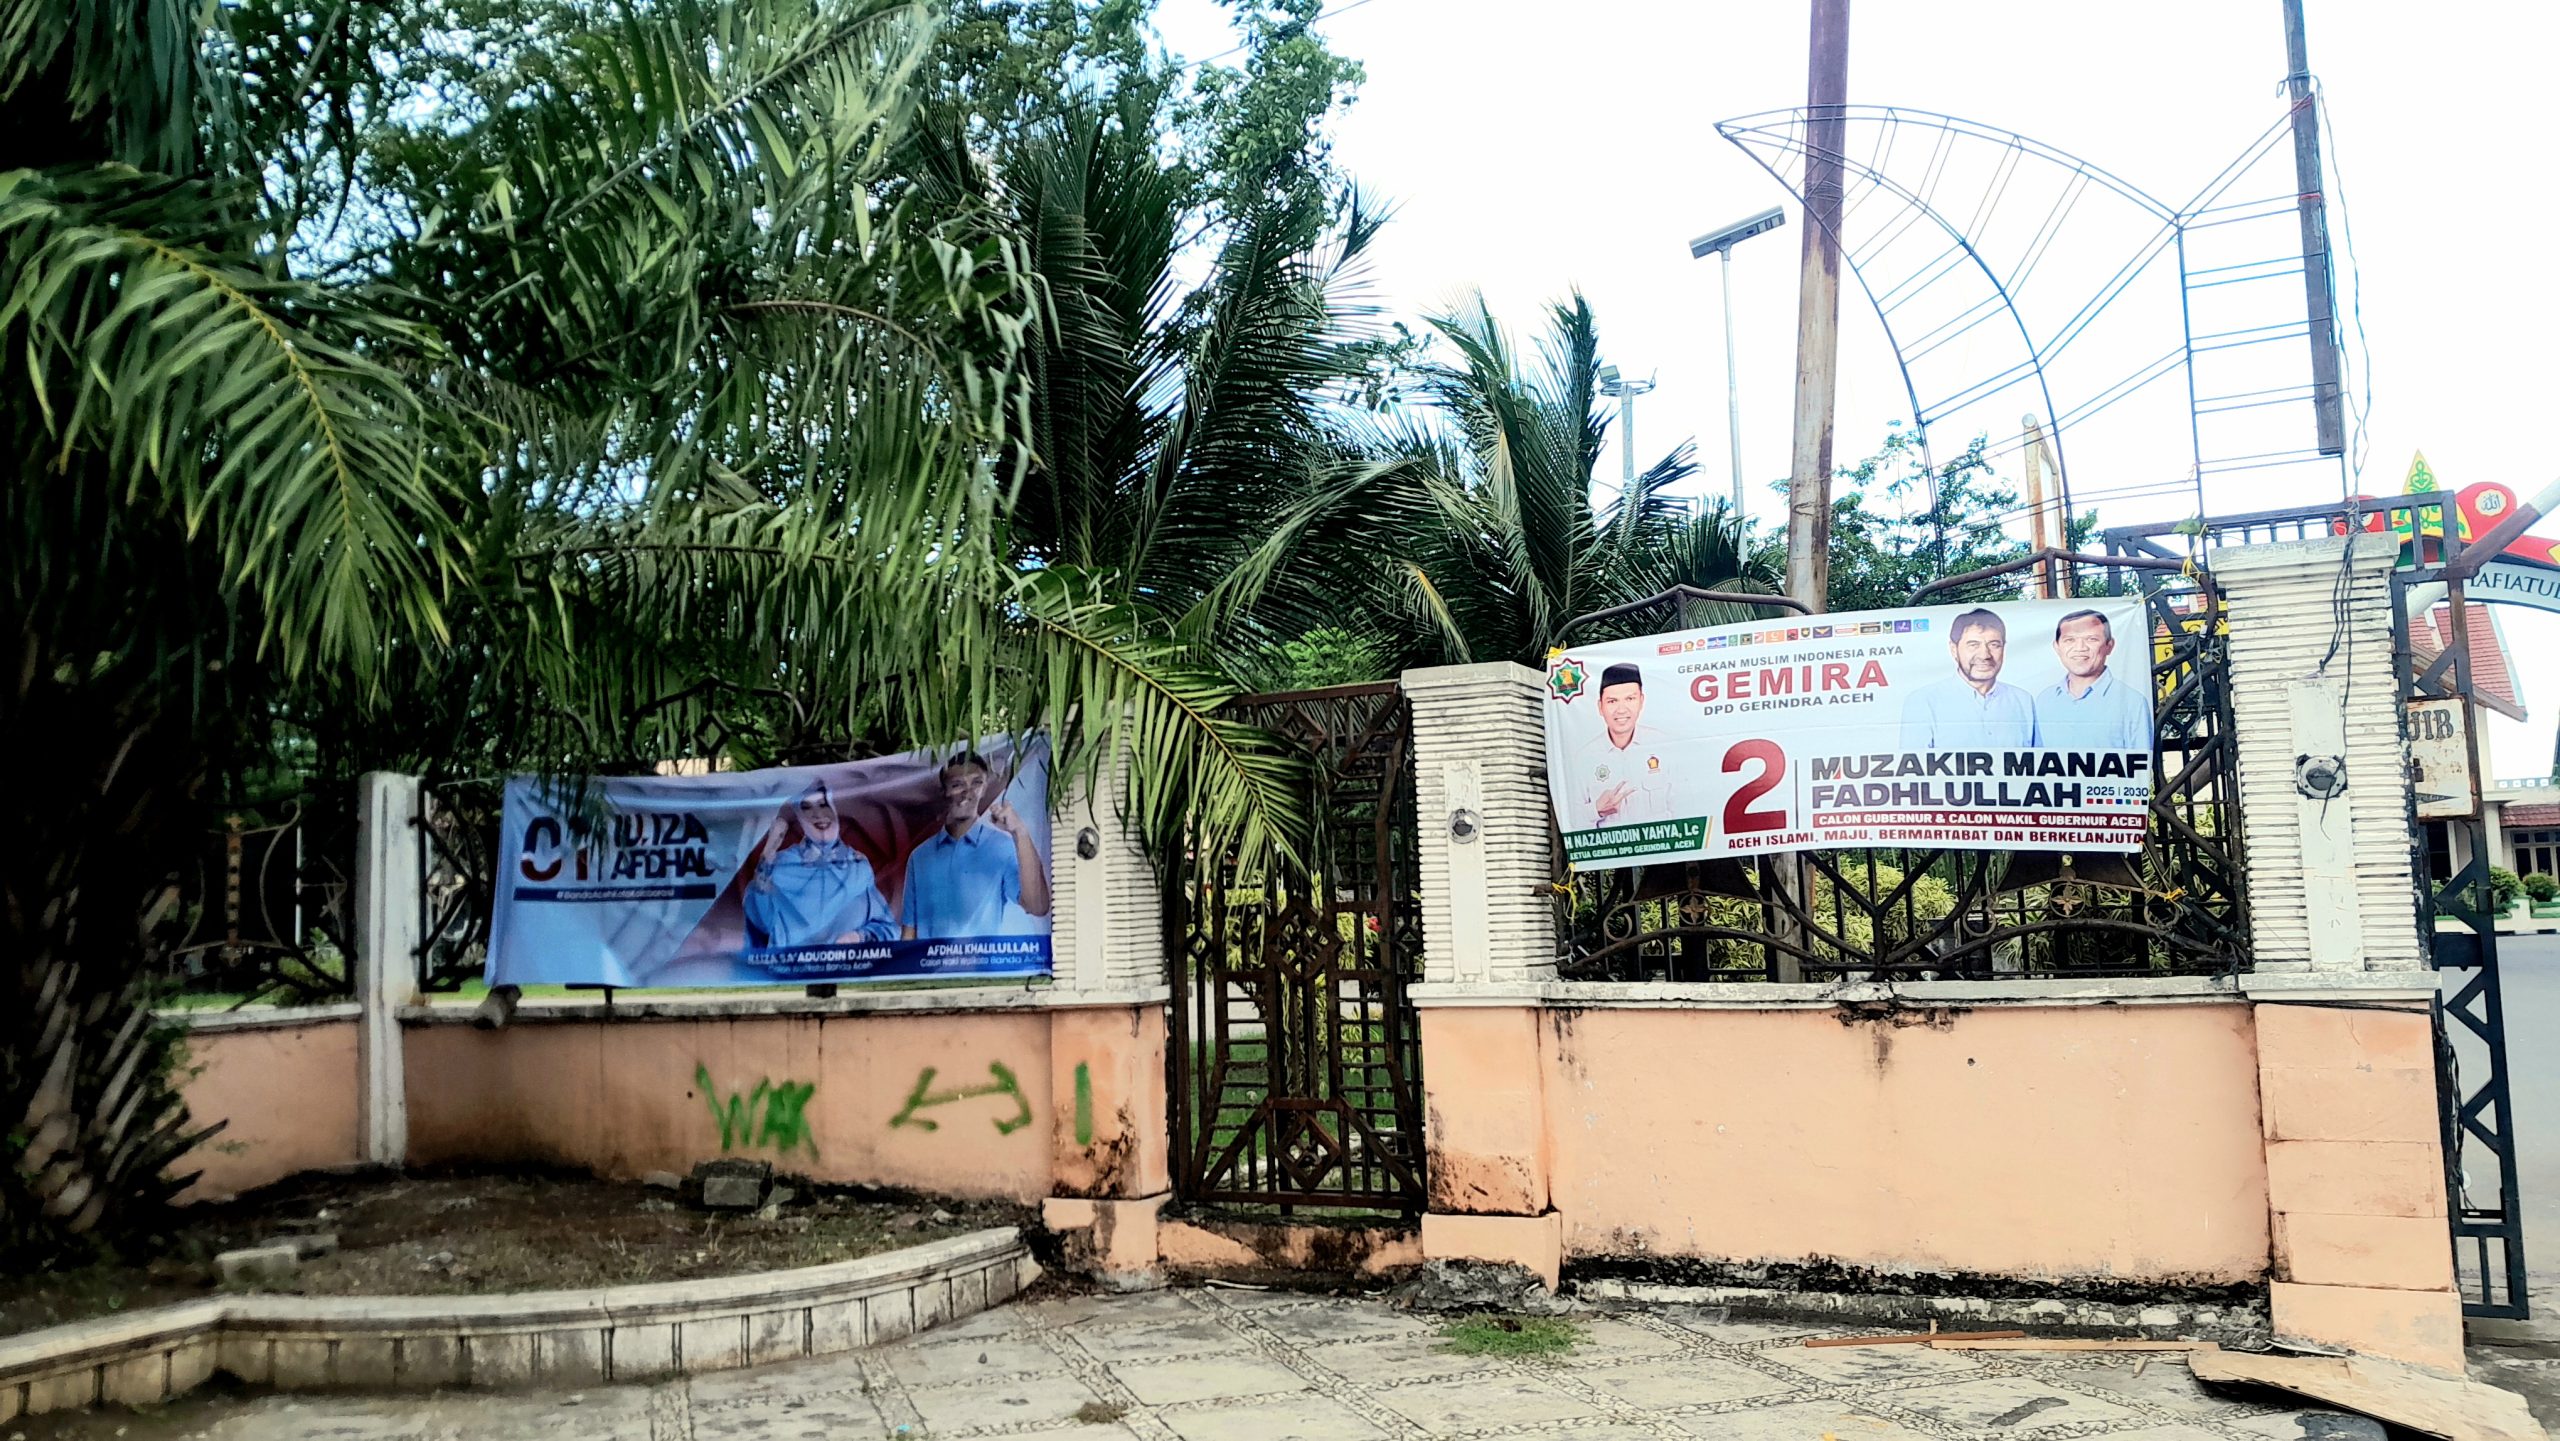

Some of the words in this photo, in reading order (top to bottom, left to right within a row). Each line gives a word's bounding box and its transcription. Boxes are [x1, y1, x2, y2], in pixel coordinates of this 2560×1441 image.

[1678, 657, 1736, 674] GERAKAN
[1740, 654, 1789, 668] MUSLIM
[1793, 648, 1867, 663] INDONESIA
[1869, 646, 1904, 657] RAYA
[1690, 660, 1889, 703] GEMIRA
[1704, 703, 1734, 716] DPD
[1740, 697, 1823, 712] GERINDRA
[1829, 692, 1874, 704] ACEH
[1811, 752, 1994, 781] MUZAKIR
[2003, 752, 2148, 778] MANAF
[1721, 738, 1787, 835] 2
[1811, 782, 2081, 809] FADHLULLAH
[2086, 786, 2115, 796] 2025
[2123, 787, 2149, 797] 2030
[1819, 813, 1861, 826] CALON
[1864, 813, 1933, 824] GUBERNUR
[1935, 813, 1946, 824] &
[1949, 813, 1992, 825] CALON
[1996, 814, 2036, 825] WAKIL
[2039, 815, 2108, 827] GUBERNUR
[2110, 816, 2142, 827] ACEH
[1574, 828, 1641, 848] NAZARUDDIN
[1642, 824, 1682, 841] YAHYA,
[1684, 822, 1699, 836] Lc
[1728, 837, 1761, 849] ACEH
[1766, 831, 1818, 845] ISLAMI,
[1824, 829, 1873, 841] MAJU,
[1879, 829, 1987, 841] BERMARTABAT
[1994, 830, 2024, 842] DAN
[1570, 850, 1591, 861] KETUA
[1592, 847, 1618, 858] GEMIRA
[1618, 845, 1633, 855] DPD
[1634, 842, 1671, 853] GERINDRA
[1674, 839, 1695, 849] ACEH
[610, 847, 715, 880] AFDHAL
[848, 947, 892, 960] DJAMAL
[927, 944, 963, 956] AFDHAL
[964, 941, 1040, 955] KHALILULLAH
[990, 955, 1022, 964] Banda
